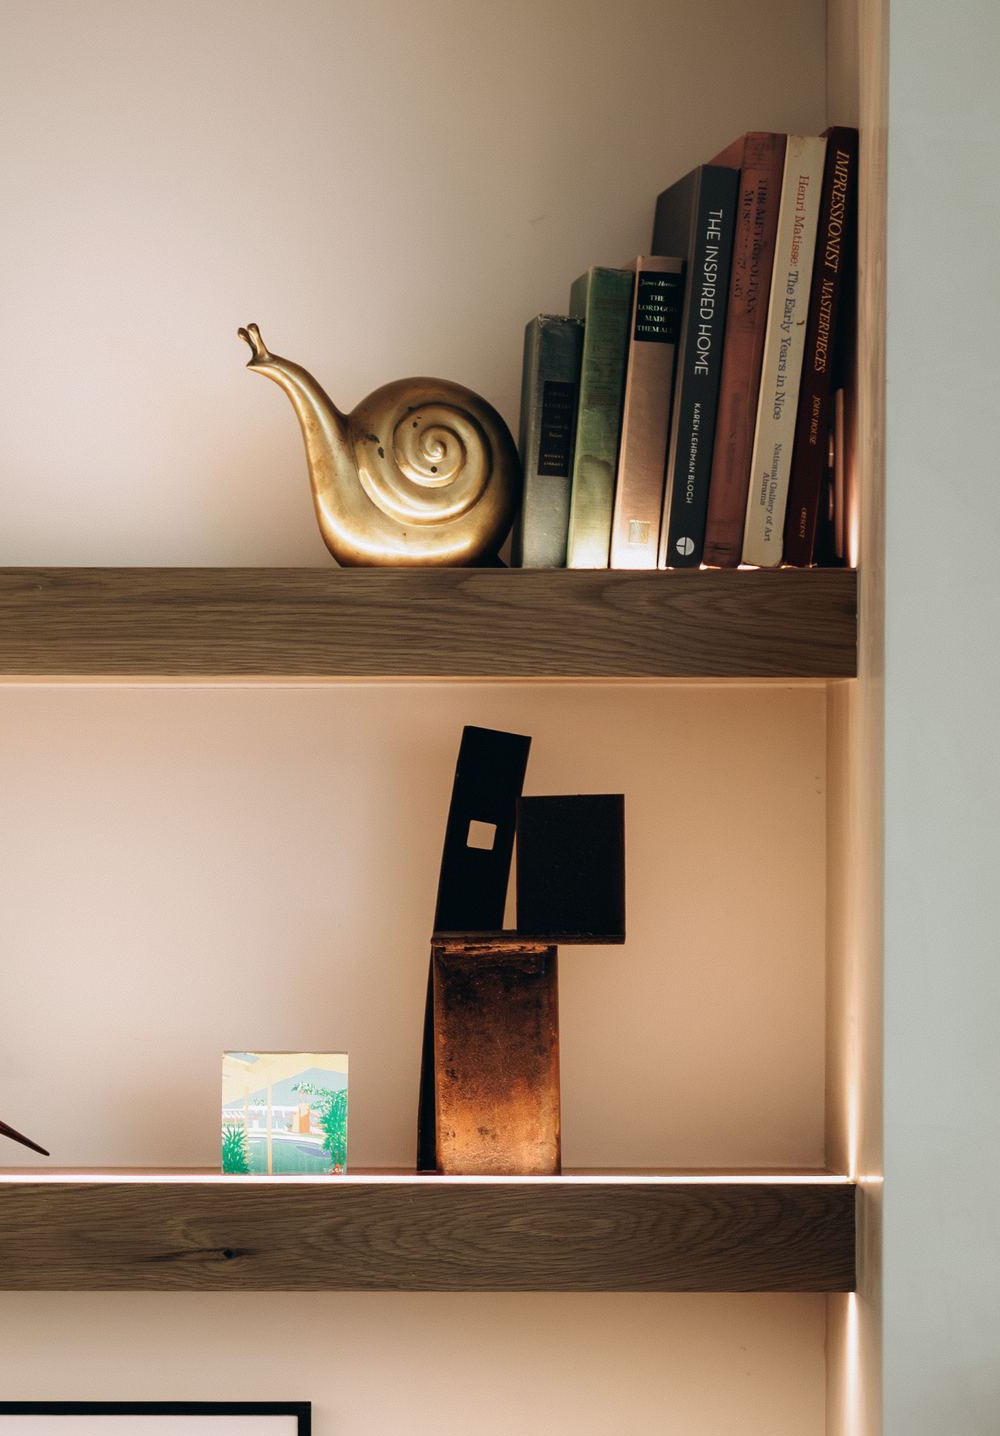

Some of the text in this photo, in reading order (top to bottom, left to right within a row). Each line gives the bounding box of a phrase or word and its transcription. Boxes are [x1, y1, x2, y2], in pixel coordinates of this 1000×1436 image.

[649, 294, 665, 302] THE
[694, 208, 723, 377] THE INSPIRED HOME
[773, 175, 810, 420] Henri Matisse: The Early Years in Nice
[814, 149, 850, 374] IMPRESSIONIST MASTERPIECES
[686, 402, 701, 504] KAREN LEHRMAN BLOCH
[759, 472, 770, 506] Abrams
[763, 443, 783, 542] National Gallery of Art
